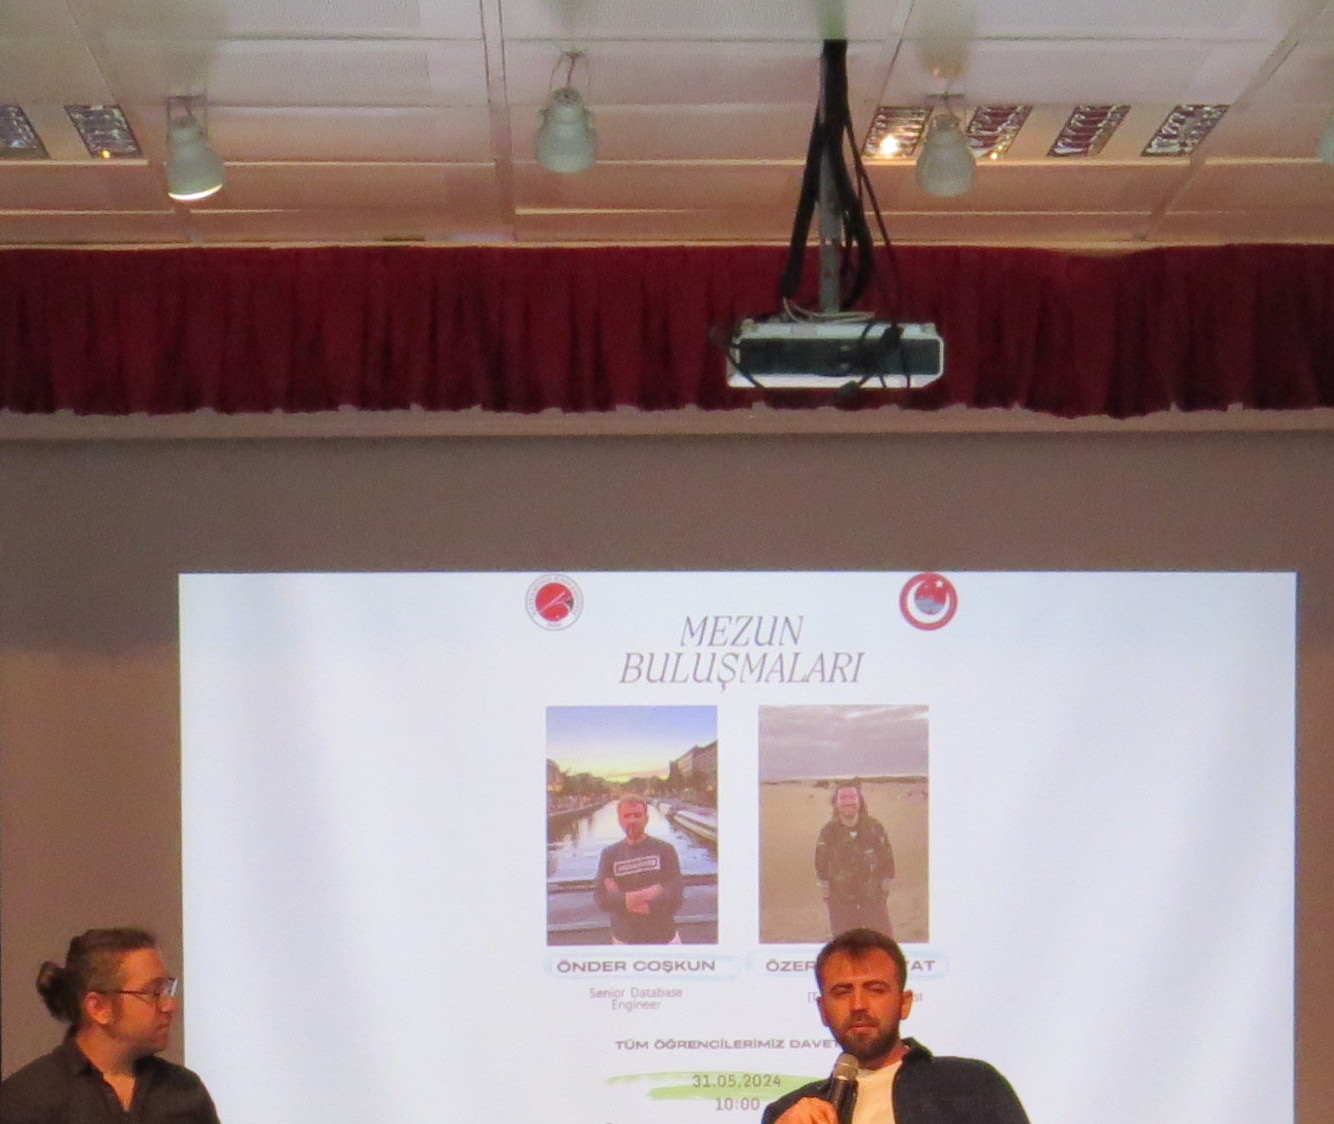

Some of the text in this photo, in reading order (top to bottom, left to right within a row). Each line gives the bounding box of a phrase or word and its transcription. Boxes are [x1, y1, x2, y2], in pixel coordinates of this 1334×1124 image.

[680, 614, 805, 647] MEZUN
[618, 651, 867, 692] BULUŞMALARI
[556, 958, 716, 974] ÖNDER COŞKUN
[766, 958, 817, 972] ÖZER
[589, 986, 684, 999] Senior Database
[611, 999, 661, 1013] Engineer
[615, 1038, 649, 1050] TÜM
[654, 1037, 785, 1050] ÖĞRENCİLERİMİZ
[692, 1073, 782, 1088] 31.05.2024
[715, 1097, 760, 1111] 10:00
